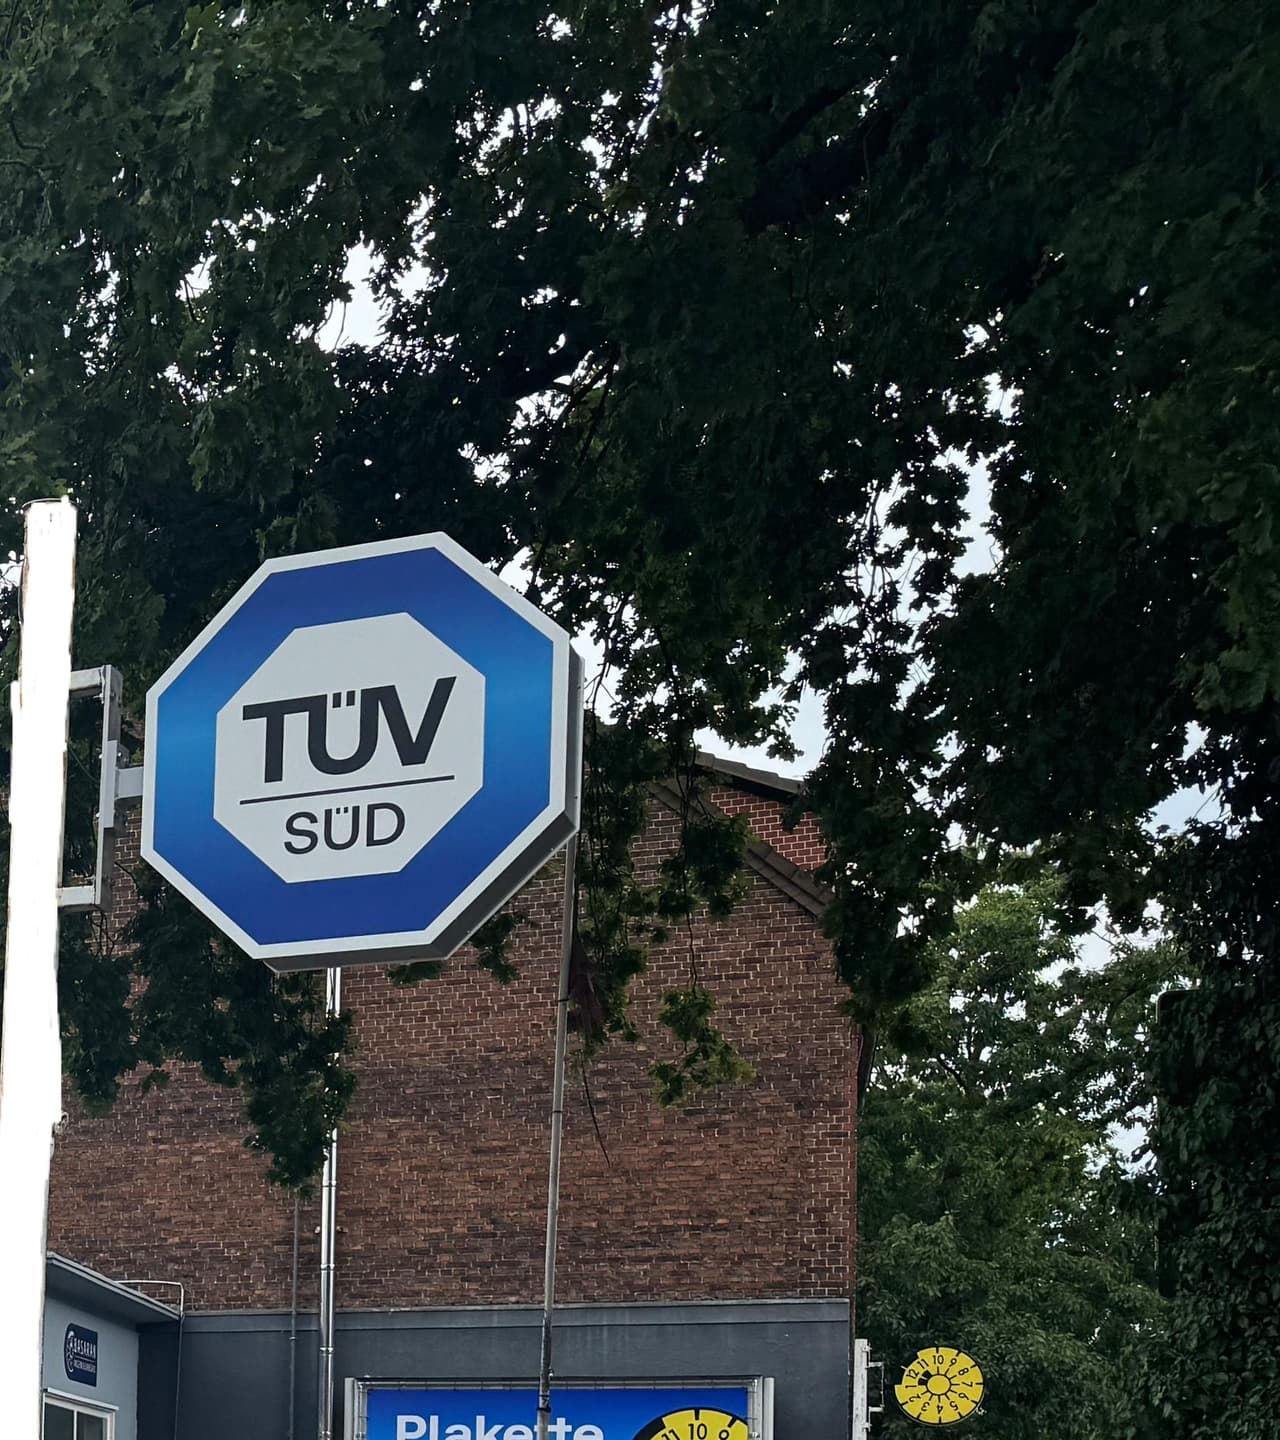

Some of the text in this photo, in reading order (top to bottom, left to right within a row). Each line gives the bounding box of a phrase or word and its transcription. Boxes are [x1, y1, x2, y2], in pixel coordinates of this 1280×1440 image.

[243, 676, 457, 783] TÜV
[284, 802, 405, 855] SÜD
[917, 1359, 929, 1369] 11
[933, 1355, 944, 1364] 10
[949, 1358, 957, 1367] 9
[906, 1369, 919, 1379] 12
[958, 1367, 969, 1375] 8
[909, 1394, 921, 1402] 2
[958, 1392, 969, 1400] 6
[921, 1402, 930, 1411] 3
[937, 1404, 944, 1414] 4
[950, 1401, 958, 1411] 5
[688, 1423, 707, 1440] 10
